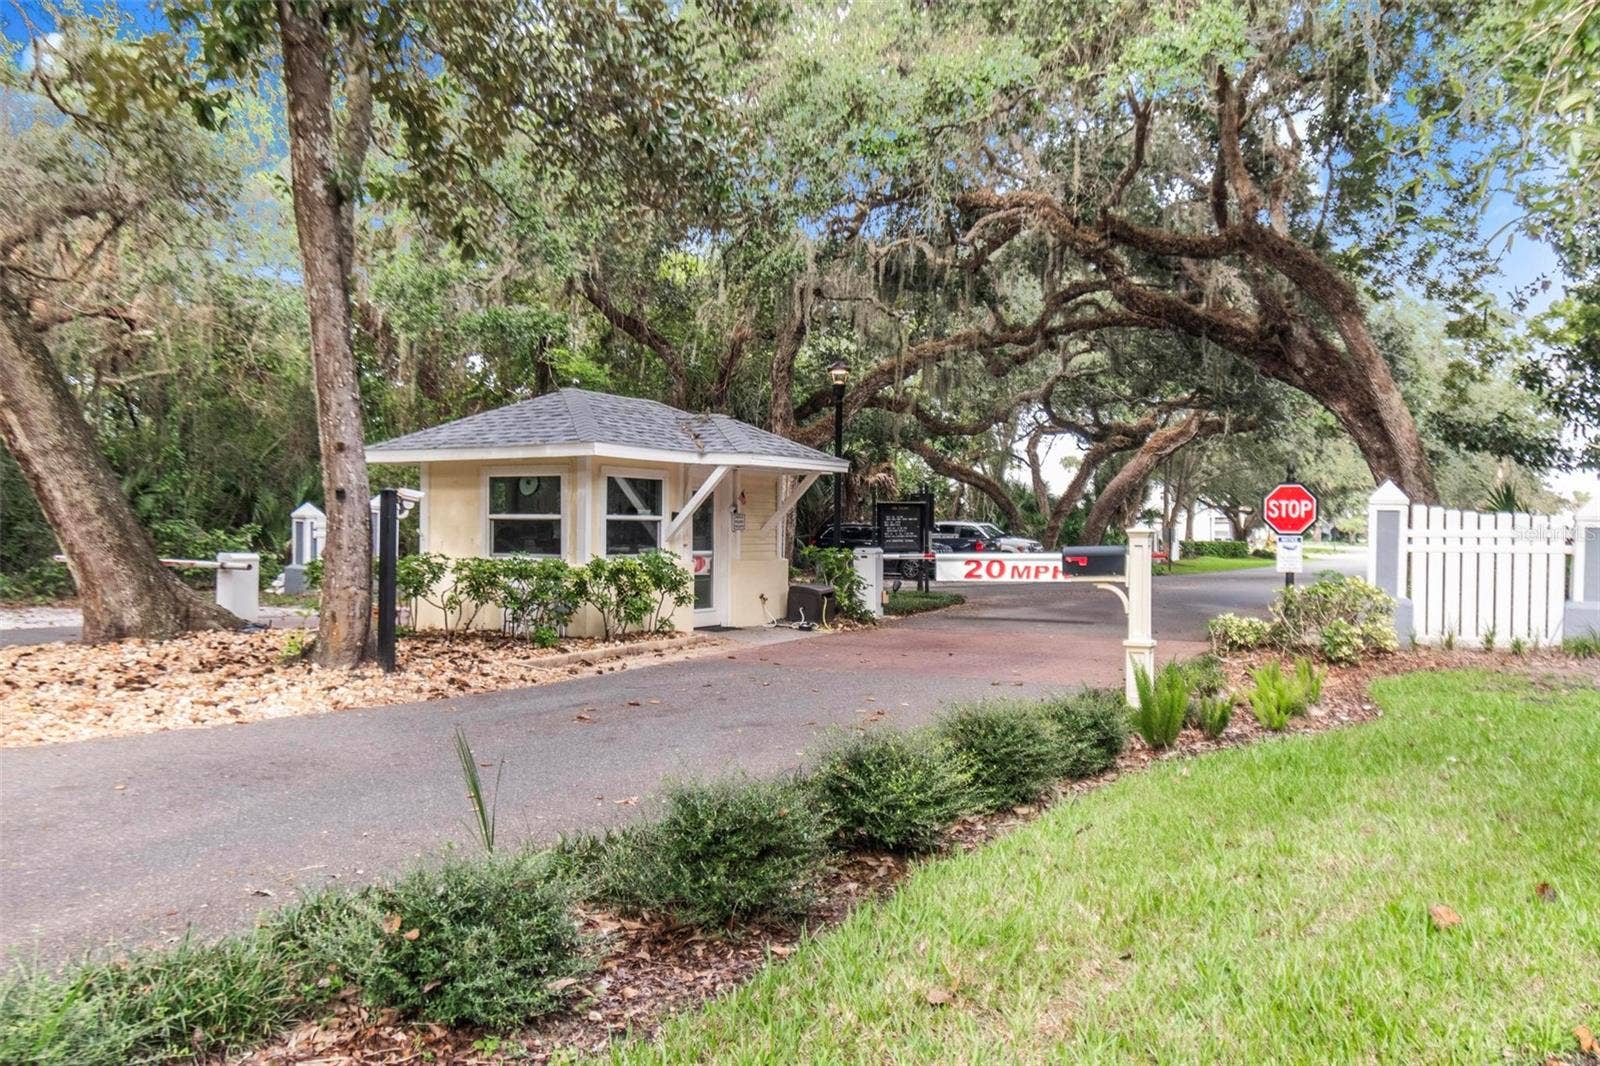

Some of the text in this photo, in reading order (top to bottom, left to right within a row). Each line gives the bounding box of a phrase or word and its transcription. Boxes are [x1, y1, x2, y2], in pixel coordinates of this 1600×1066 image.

[1268, 500, 1312, 518] STOP
[963, 559, 1071, 580] 20 MPH
